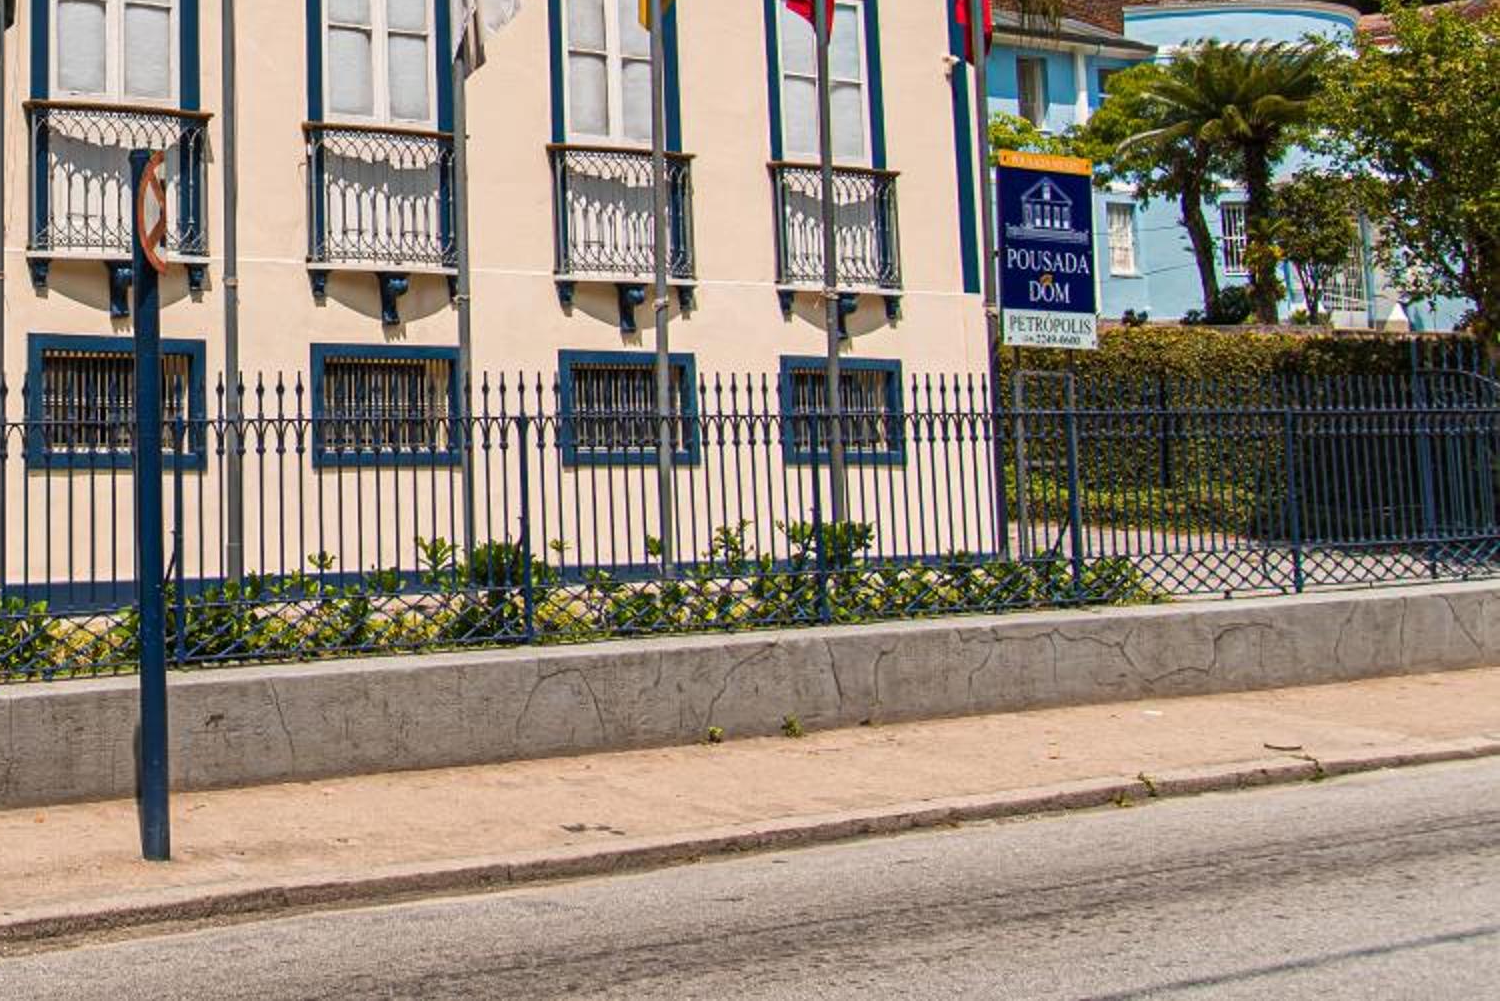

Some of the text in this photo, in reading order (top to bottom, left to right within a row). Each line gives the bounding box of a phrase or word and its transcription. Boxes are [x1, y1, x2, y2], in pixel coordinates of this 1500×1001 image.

[1007, 247, 1090, 274] POUSADA
[1028, 280, 1071, 304] DOM
[1009, 312, 1092, 335] PETRÓPOLIS
